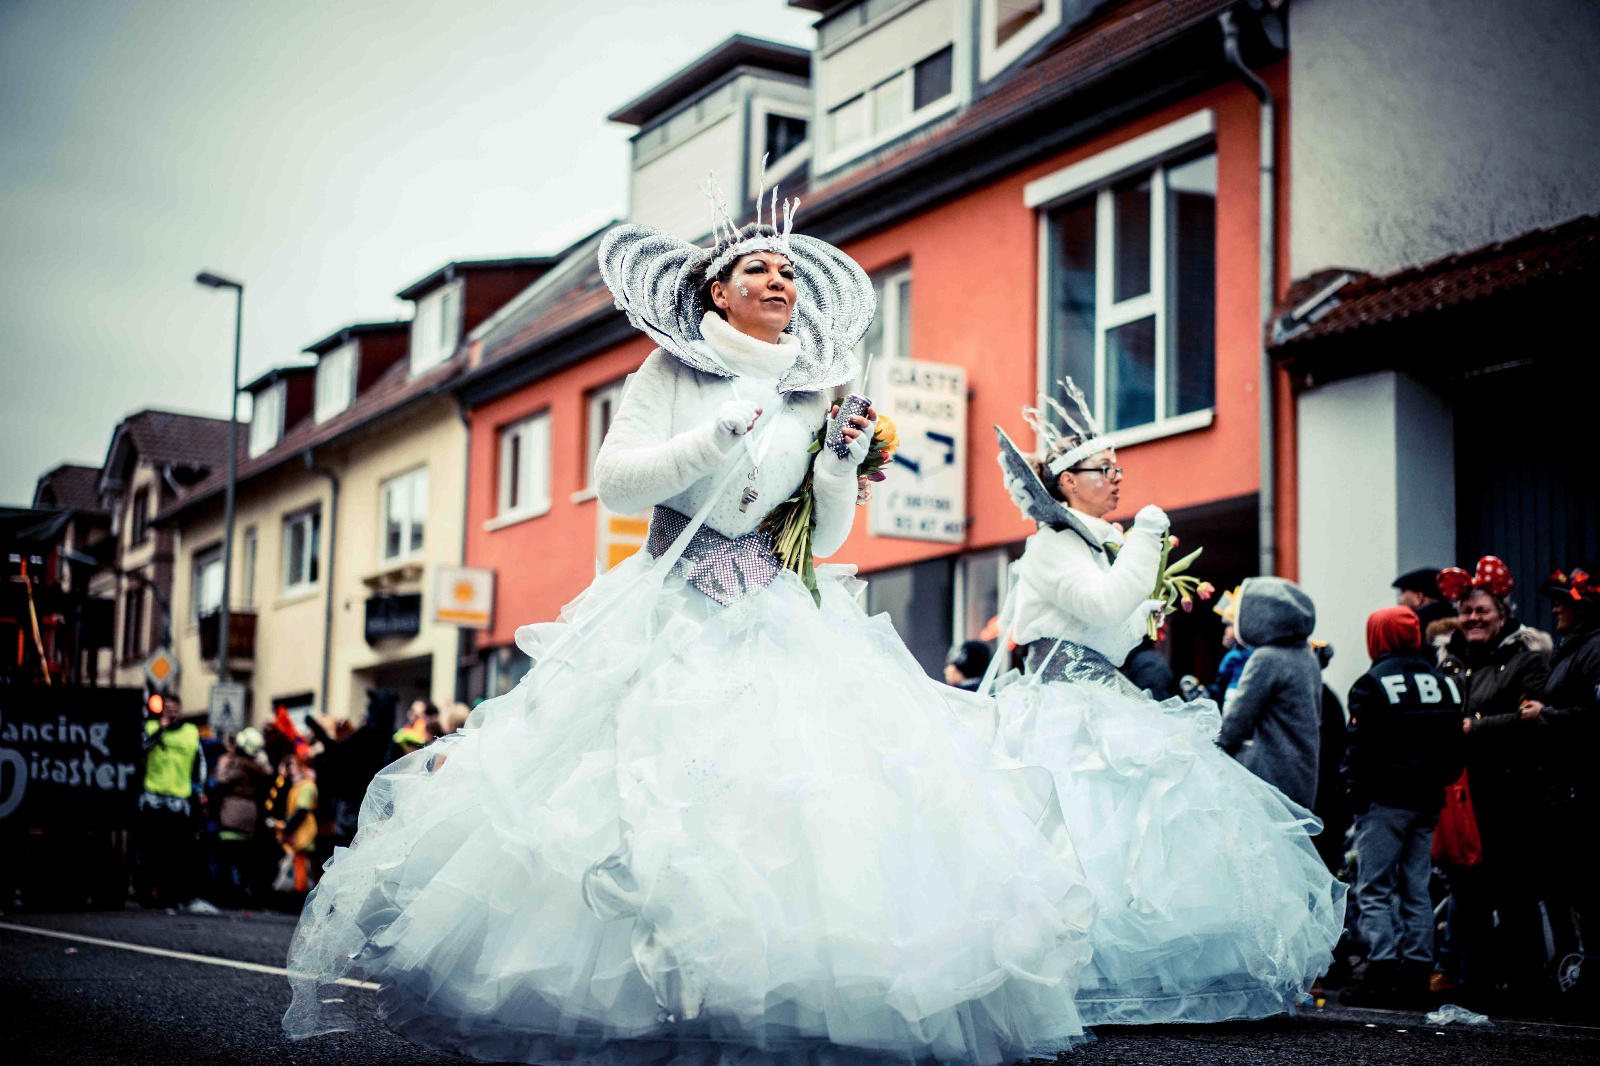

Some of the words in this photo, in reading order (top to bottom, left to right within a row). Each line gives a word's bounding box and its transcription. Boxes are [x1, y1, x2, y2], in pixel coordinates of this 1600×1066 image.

[895, 398, 954, 419] HAUS
[1380, 673, 1462, 704] FBI
[0, 712, 110, 757] ancing
[0, 747, 136, 820] Disaster
